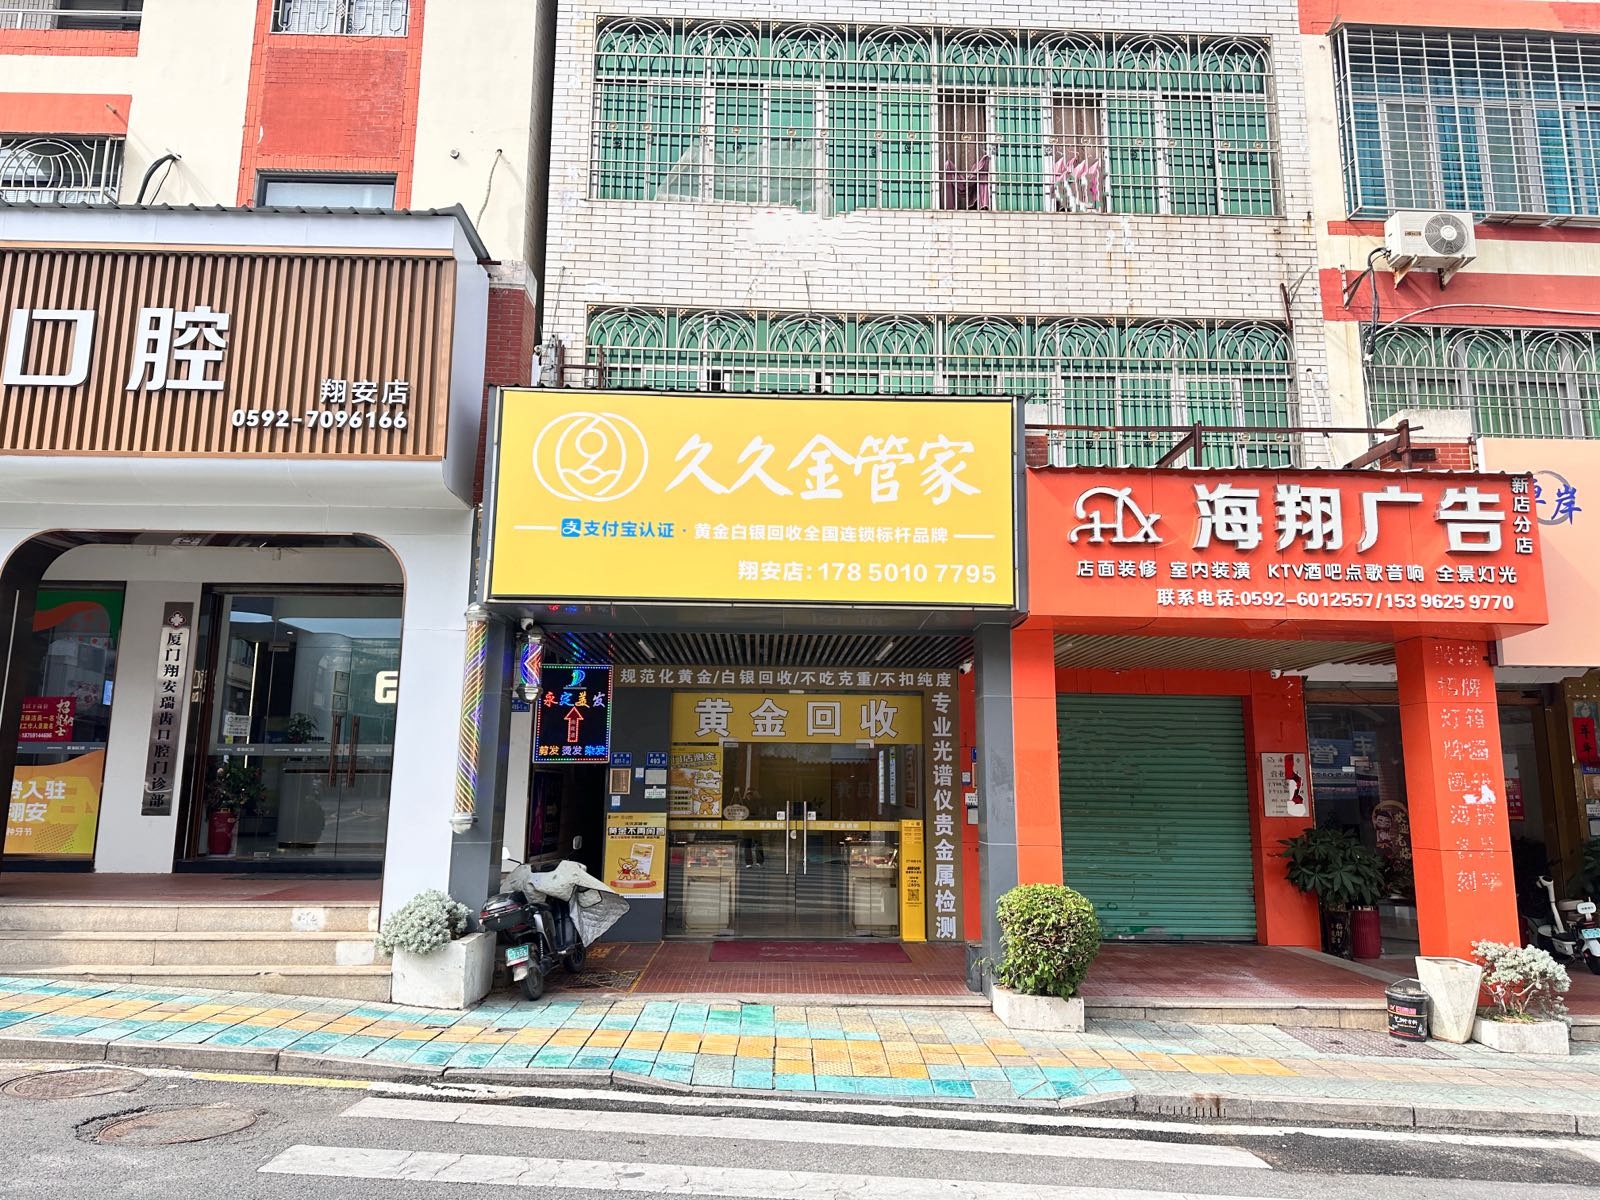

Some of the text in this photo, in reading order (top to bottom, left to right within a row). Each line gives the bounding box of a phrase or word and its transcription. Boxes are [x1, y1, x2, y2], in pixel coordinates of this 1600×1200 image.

[3, 305, 231, 392] 口腔
[320, 378, 410, 405] 翔安店
[231, 408, 408, 430] 0592-7096166
[664, 432, 983, 505] 久久金管家
[1192, 482, 1506, 554] 海翔广告
[1511, 477, 1534, 553] 新店分店
[584, 521, 675, 539] 支付宝认证
[694, 523, 949, 545] 黄金白银回收全国连锁标杆品牌
[868, 563, 929, 584] 5010
[935, 564, 996, 585] 7795
[1076, 560, 1519, 584] 店面装修 室内装潢 KTV酒吧点歌音响 全景灯光
[1420, 593, 1466, 609] 9625
[1468, 594, 1514, 610] 9770
[619, 668, 952, 688] 规范化黄金/白银回收/不吃克重/不扣纯度
[149, 632, 182, 808] 厦门翔安瑞齿口腔门诊部
[694, 698, 899, 739] 黄金回收
[931, 692, 957, 940] 专业光谱仪贵金属检测
